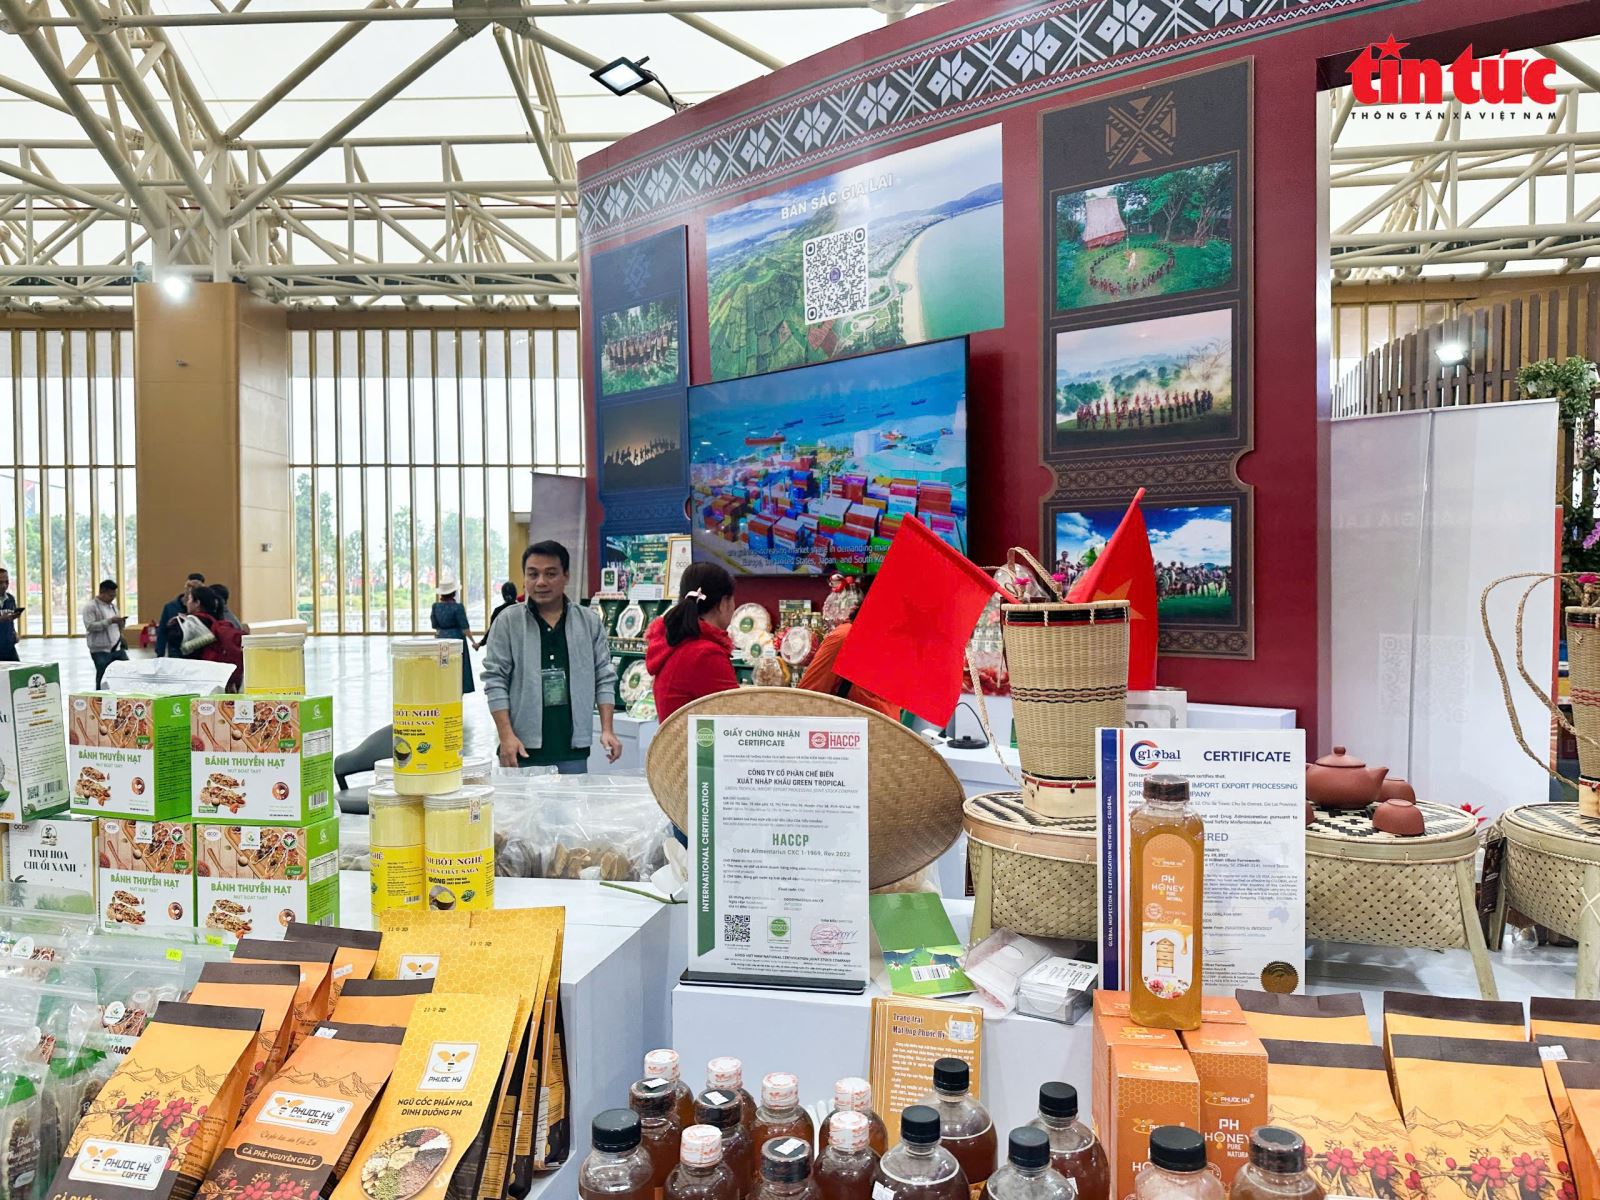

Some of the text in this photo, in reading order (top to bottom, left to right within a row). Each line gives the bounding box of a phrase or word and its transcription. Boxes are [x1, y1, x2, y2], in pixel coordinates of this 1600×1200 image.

[781, 174, 893, 220] BẢN SẮC GIA LAI
[837, 544, 873, 554] demanding
[853, 555, 871, 564] South
[412, 707, 441, 718] NGHỆ
[723, 727, 800, 739] GIẤY CHỨNG NHẬN
[738, 739, 785, 747] CERTIFICATE
[829, 734, 861, 747] HACCP
[78, 749, 142, 765] BÁNH THUYỀN HẠT
[205, 754, 285, 769] BÁNH THUYỀN HẠT
[1203, 750, 1291, 763] CERTIFICATE
[747, 769, 766, 777] CÔNG
[793, 778, 813, 786] GREEN
[814, 779, 846, 787] TROPICAL
[1221, 782, 1249, 790] EXPORT
[1251, 782, 1298, 790] PROCESSING
[1128, 790, 1143, 798] JOIN
[772, 833, 809, 847] HACCP
[28, 849, 69, 860] TINH HOA
[435, 853, 483, 866] BỘT NGHỆ
[24, 858, 76, 872] CHUỐI XANH
[110, 873, 180, 890] BÁNH THUYỀN HẠT
[428, 876, 446, 885] KHÔNG
[1161, 874, 1175, 883] PH
[211, 881, 292, 897] BÁNH THUYỀN HẠT
[1151, 883, 1184, 892] HONEY
[415, 1096, 432, 1106] CỐC
[456, 1099, 473, 1107] HOA
[306, 1117, 330, 1127] COFFEE
[1219, 1119, 1240, 1130] PH
[267, 1152, 298, 1164] NGUYÊN
[297, 1155, 317, 1166] CHẤT
[1227, 1150, 1249, 1158] NATURA
[121, 1170, 148, 1181] COFFEE
